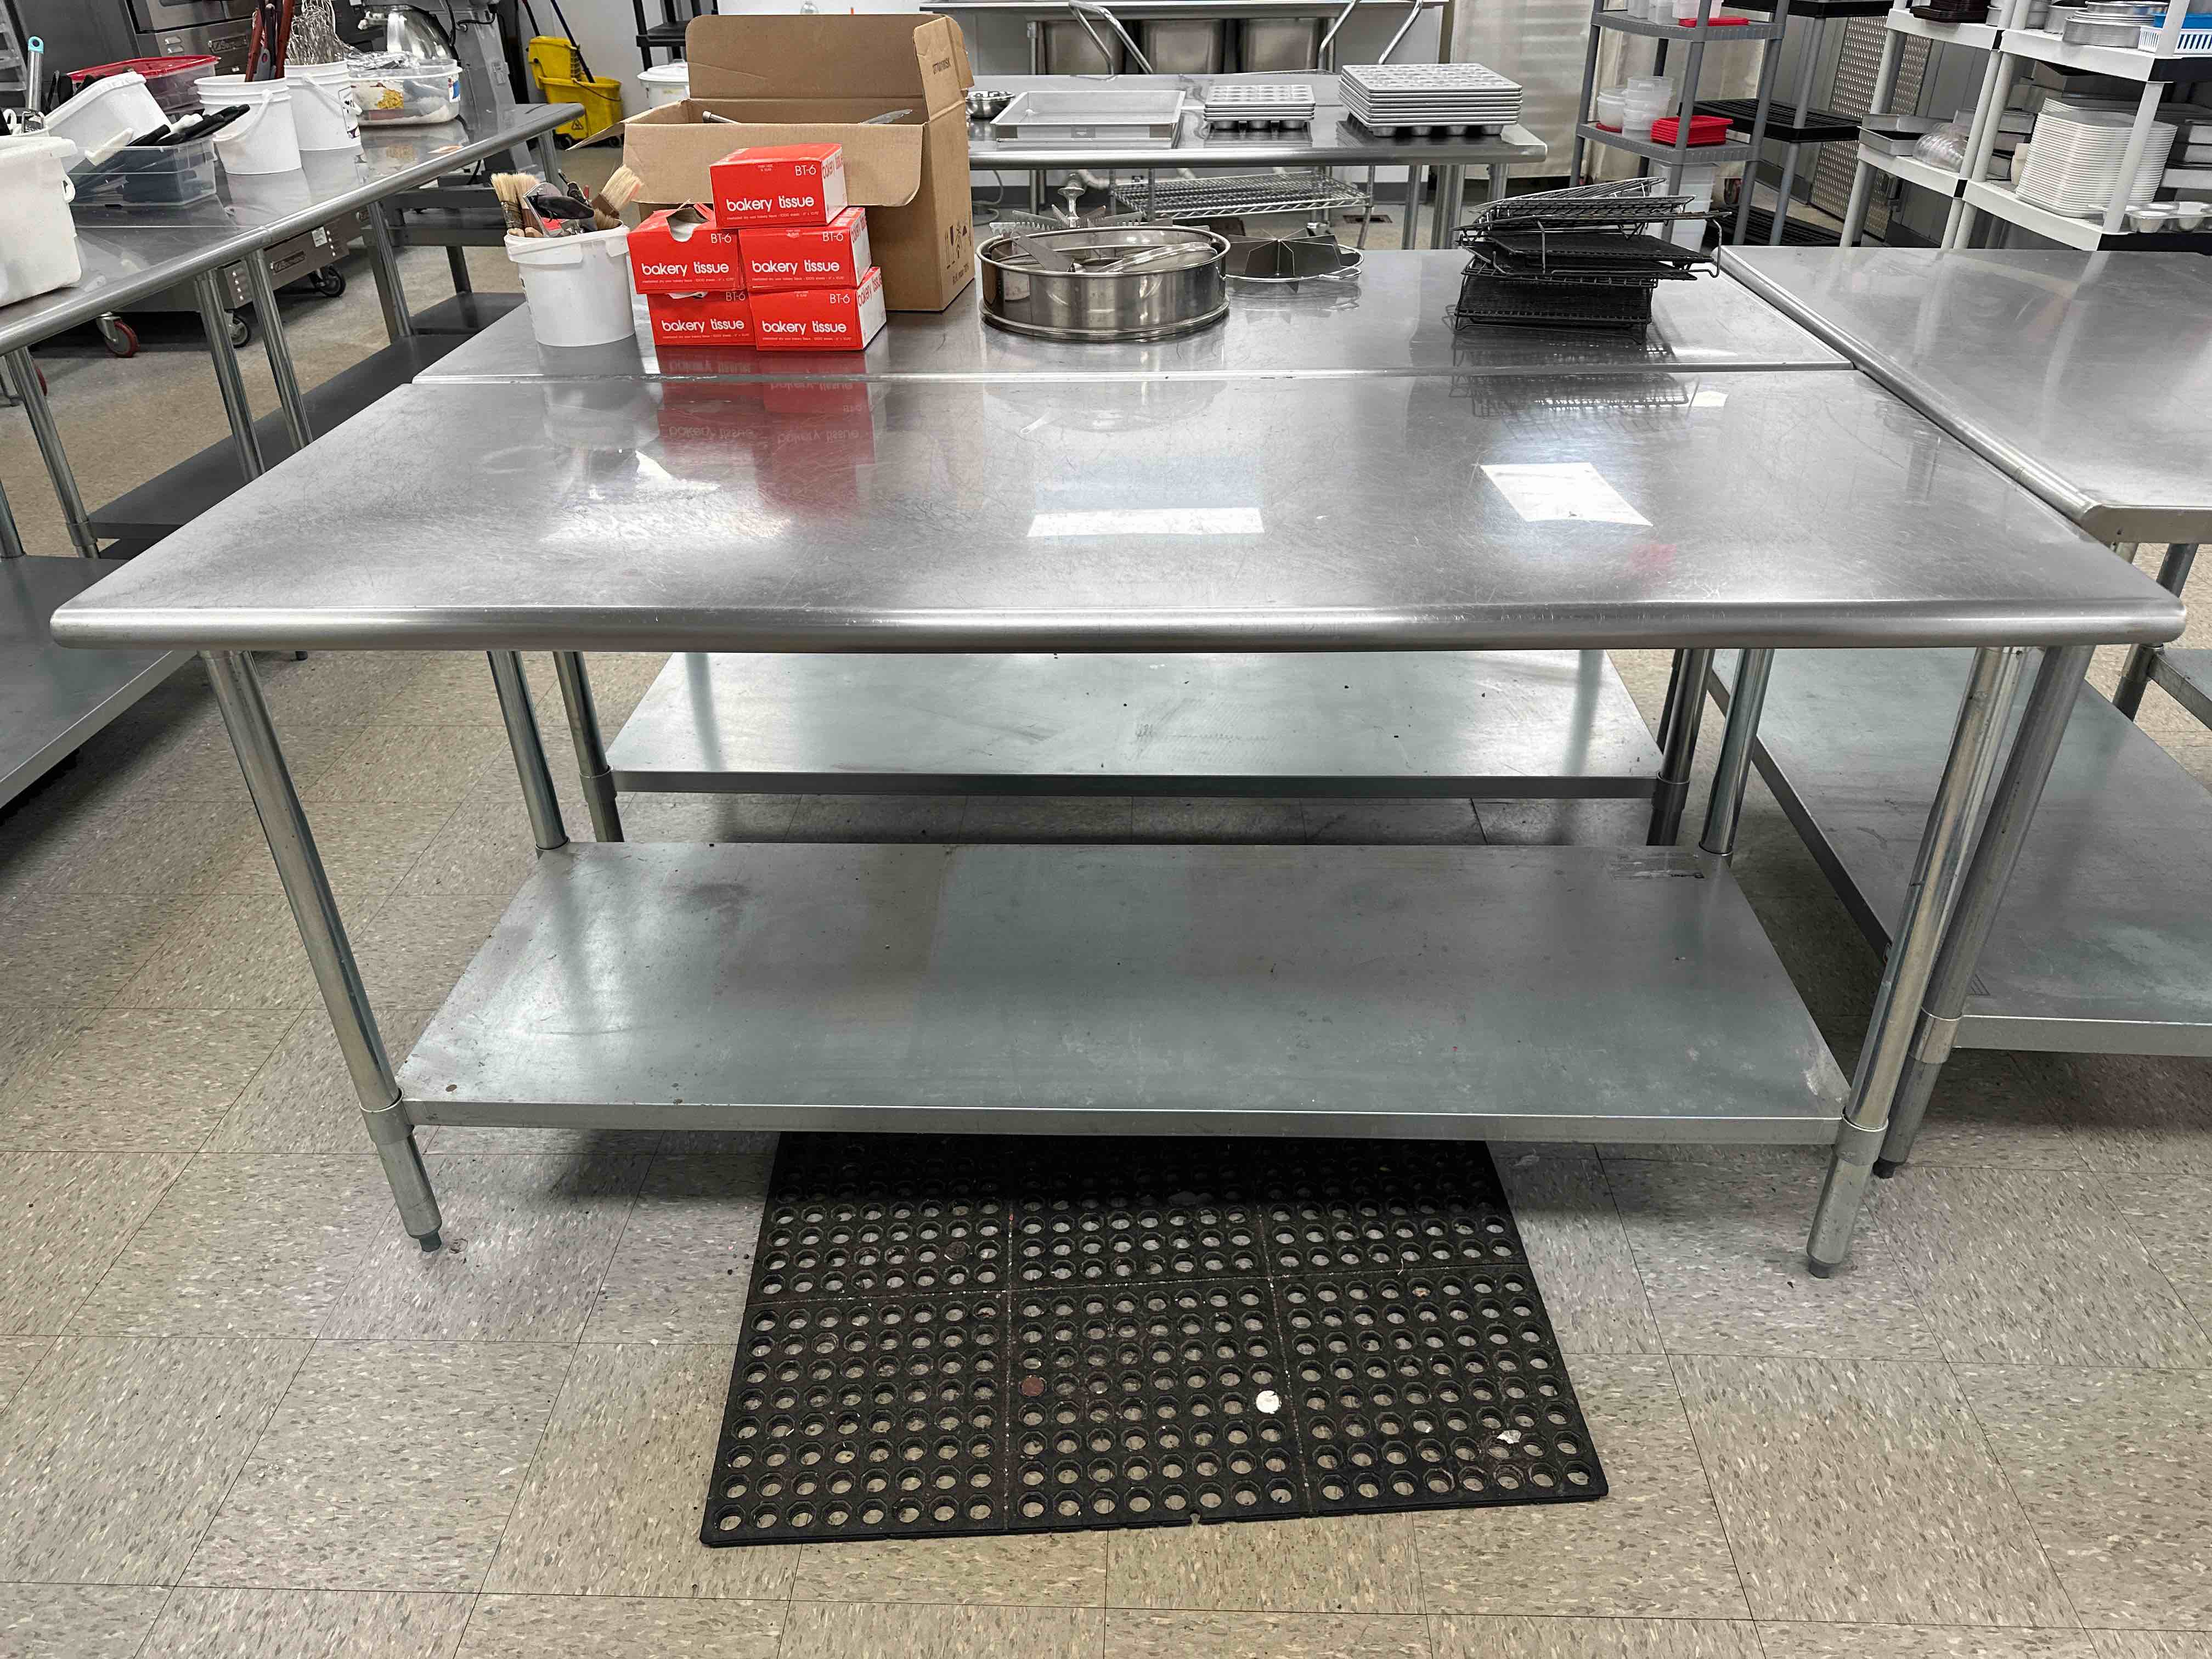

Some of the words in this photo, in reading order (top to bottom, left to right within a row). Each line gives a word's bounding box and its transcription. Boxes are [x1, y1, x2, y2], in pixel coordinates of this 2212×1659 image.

[795, 165, 816, 176] BT-6
[726, 198, 772, 212] bakery
[778, 195, 814, 208] tissue
[710, 233, 732, 244] BT-6
[822, 231, 843, 241] BT-6
[641, 262, 688, 276] bakery
[693, 261, 729, 274] tissue
[752, 259, 798, 275] bakery
[804, 259, 840, 272] tissue
[725, 291, 746, 302] BT-6
[830, 294, 850, 304] BT-6
[662, 319, 705, 332] bakery
[710, 318, 744, 330] tissue
[762, 320, 806, 335] bakery
[811, 320, 847, 333] tissue
